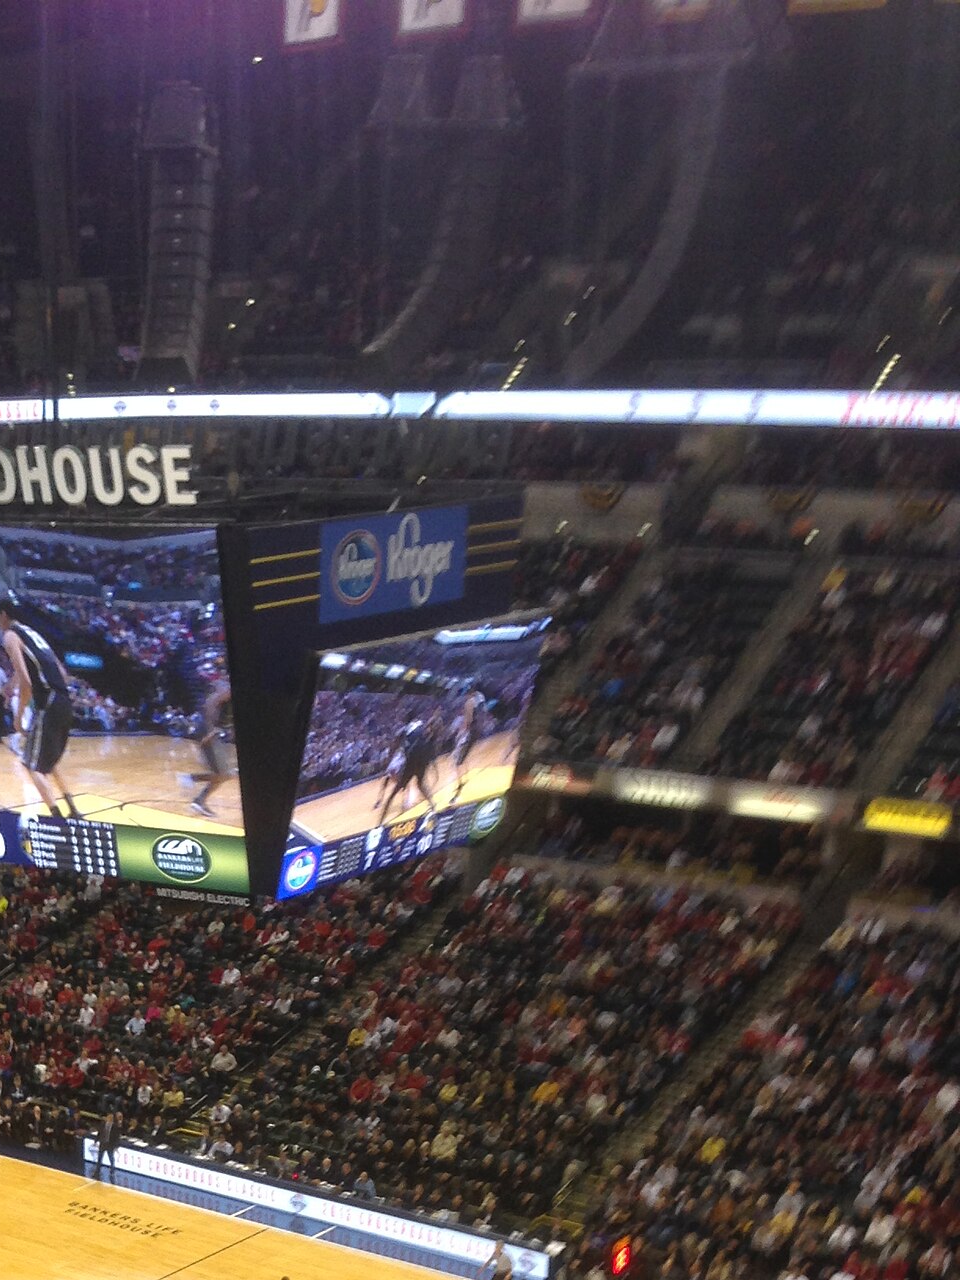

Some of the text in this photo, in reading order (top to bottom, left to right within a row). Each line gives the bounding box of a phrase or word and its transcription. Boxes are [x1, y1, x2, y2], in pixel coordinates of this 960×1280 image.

[386, 512, 455, 607] Kroger
[156, 887, 251, 907] MITSUBISHI ELECTRIC
[147, 1158, 221, 1188] CROSSROADS
[226, 1178, 276, 1203] CLASSIC
[64, 1208, 163, 1238] FIELDHOUSE
[67, 1201, 183, 1235] BANKERS LIFE
[358, 1212, 443, 1246] CROSSROADS
